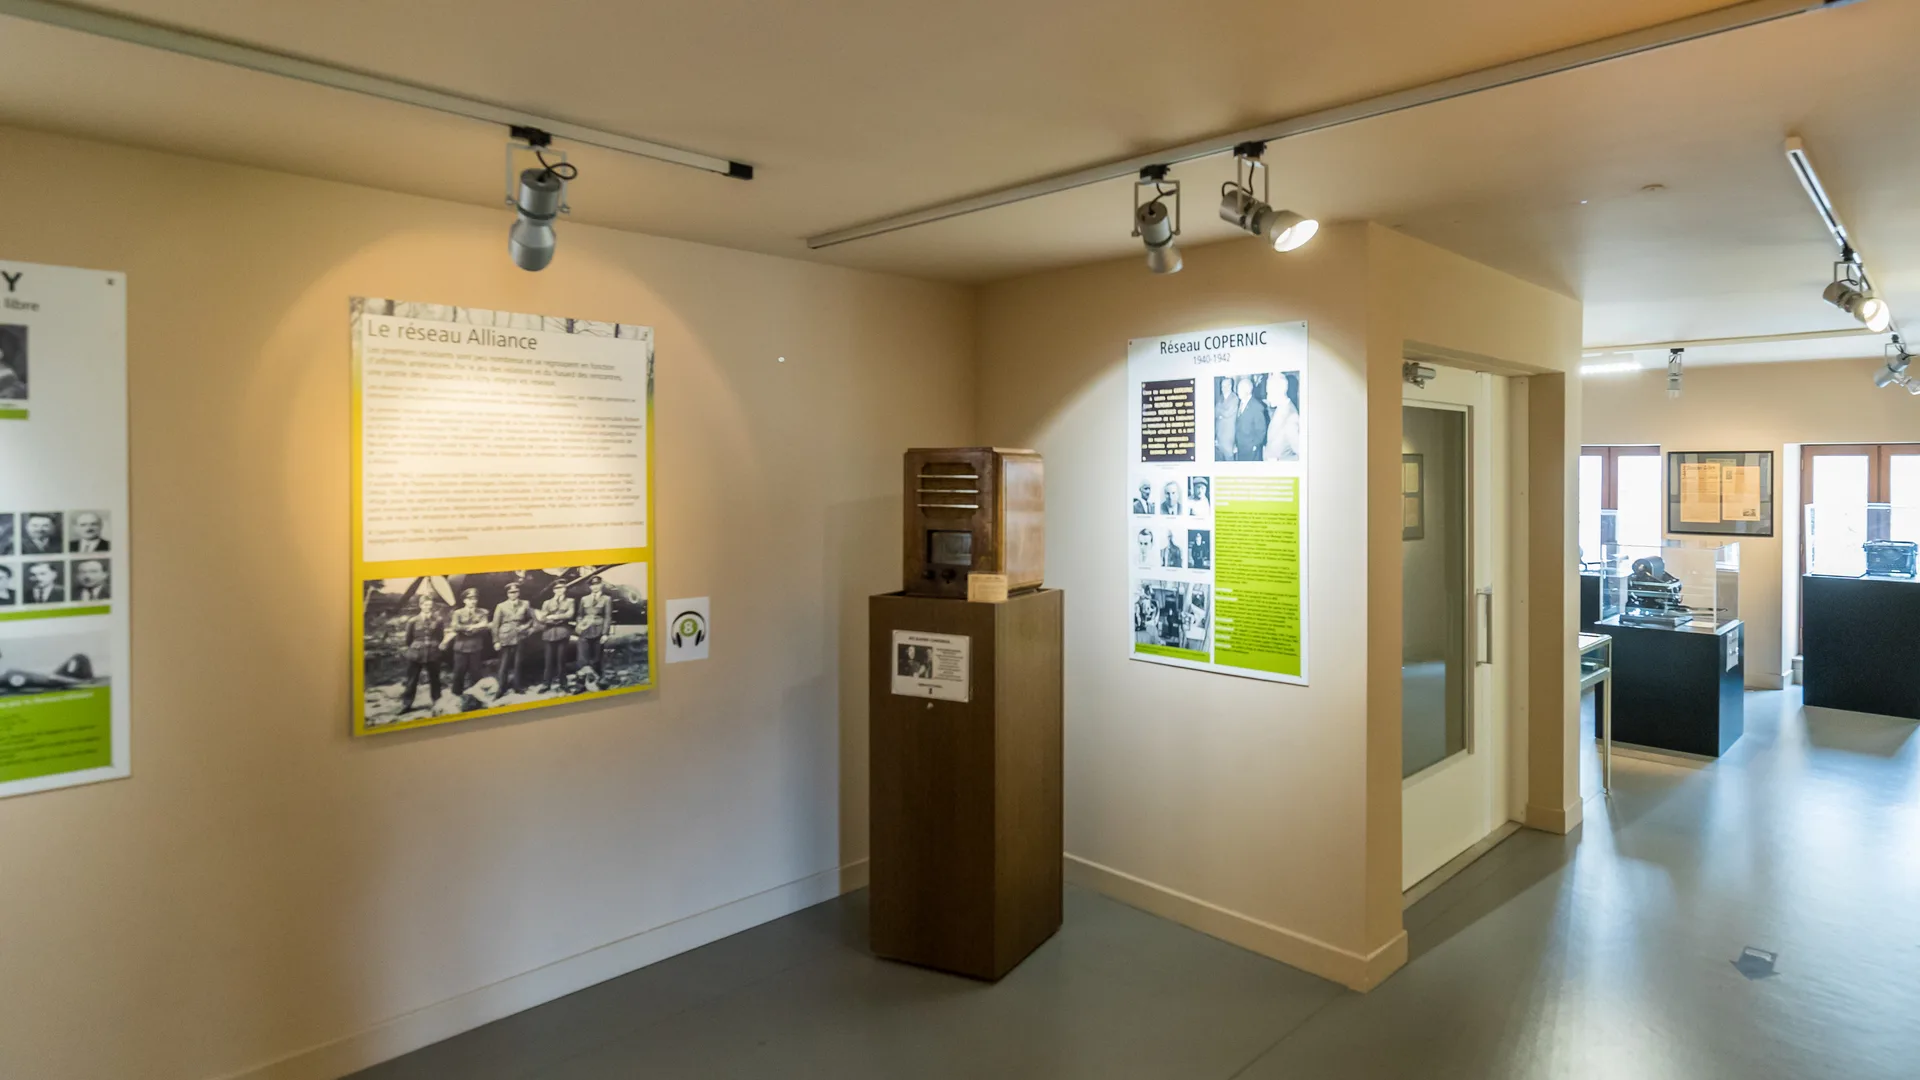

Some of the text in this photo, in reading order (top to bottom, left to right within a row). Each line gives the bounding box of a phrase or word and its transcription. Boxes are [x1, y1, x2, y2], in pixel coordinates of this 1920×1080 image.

[368, 319, 538, 350] Le réseau Alliance
[1160, 331, 1267, 355] Réseau COPERNIC
[1193, 353, 1231, 365] 1940-1942
[684, 621, 693, 634] 8
